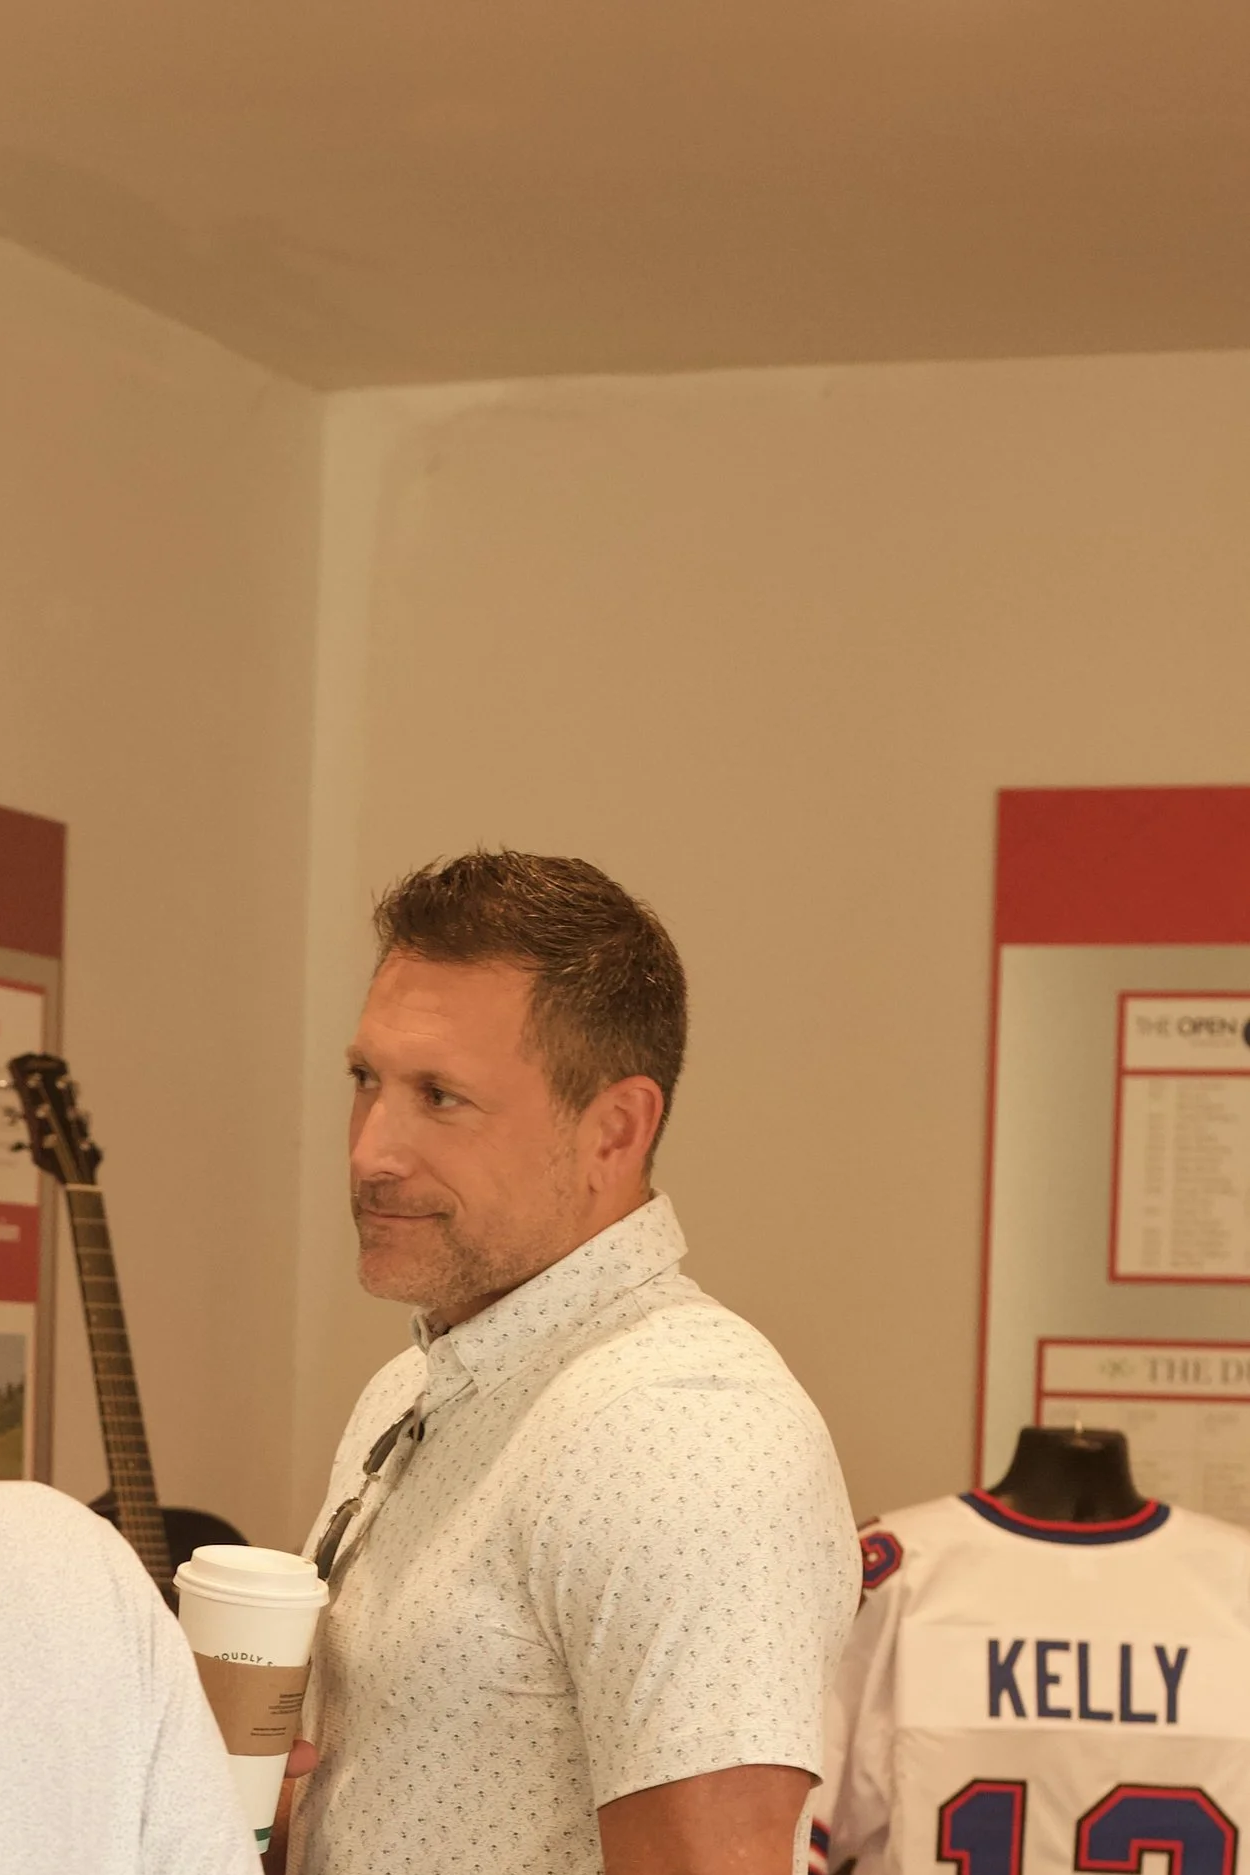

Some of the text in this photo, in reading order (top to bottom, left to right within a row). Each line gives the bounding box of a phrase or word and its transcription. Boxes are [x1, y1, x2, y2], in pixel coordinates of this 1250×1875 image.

[1177, 1015, 1238, 1037] OPEN
[1144, 1355, 1250, 1387] THE D
[986, 1638, 1189, 1725] KELLY
